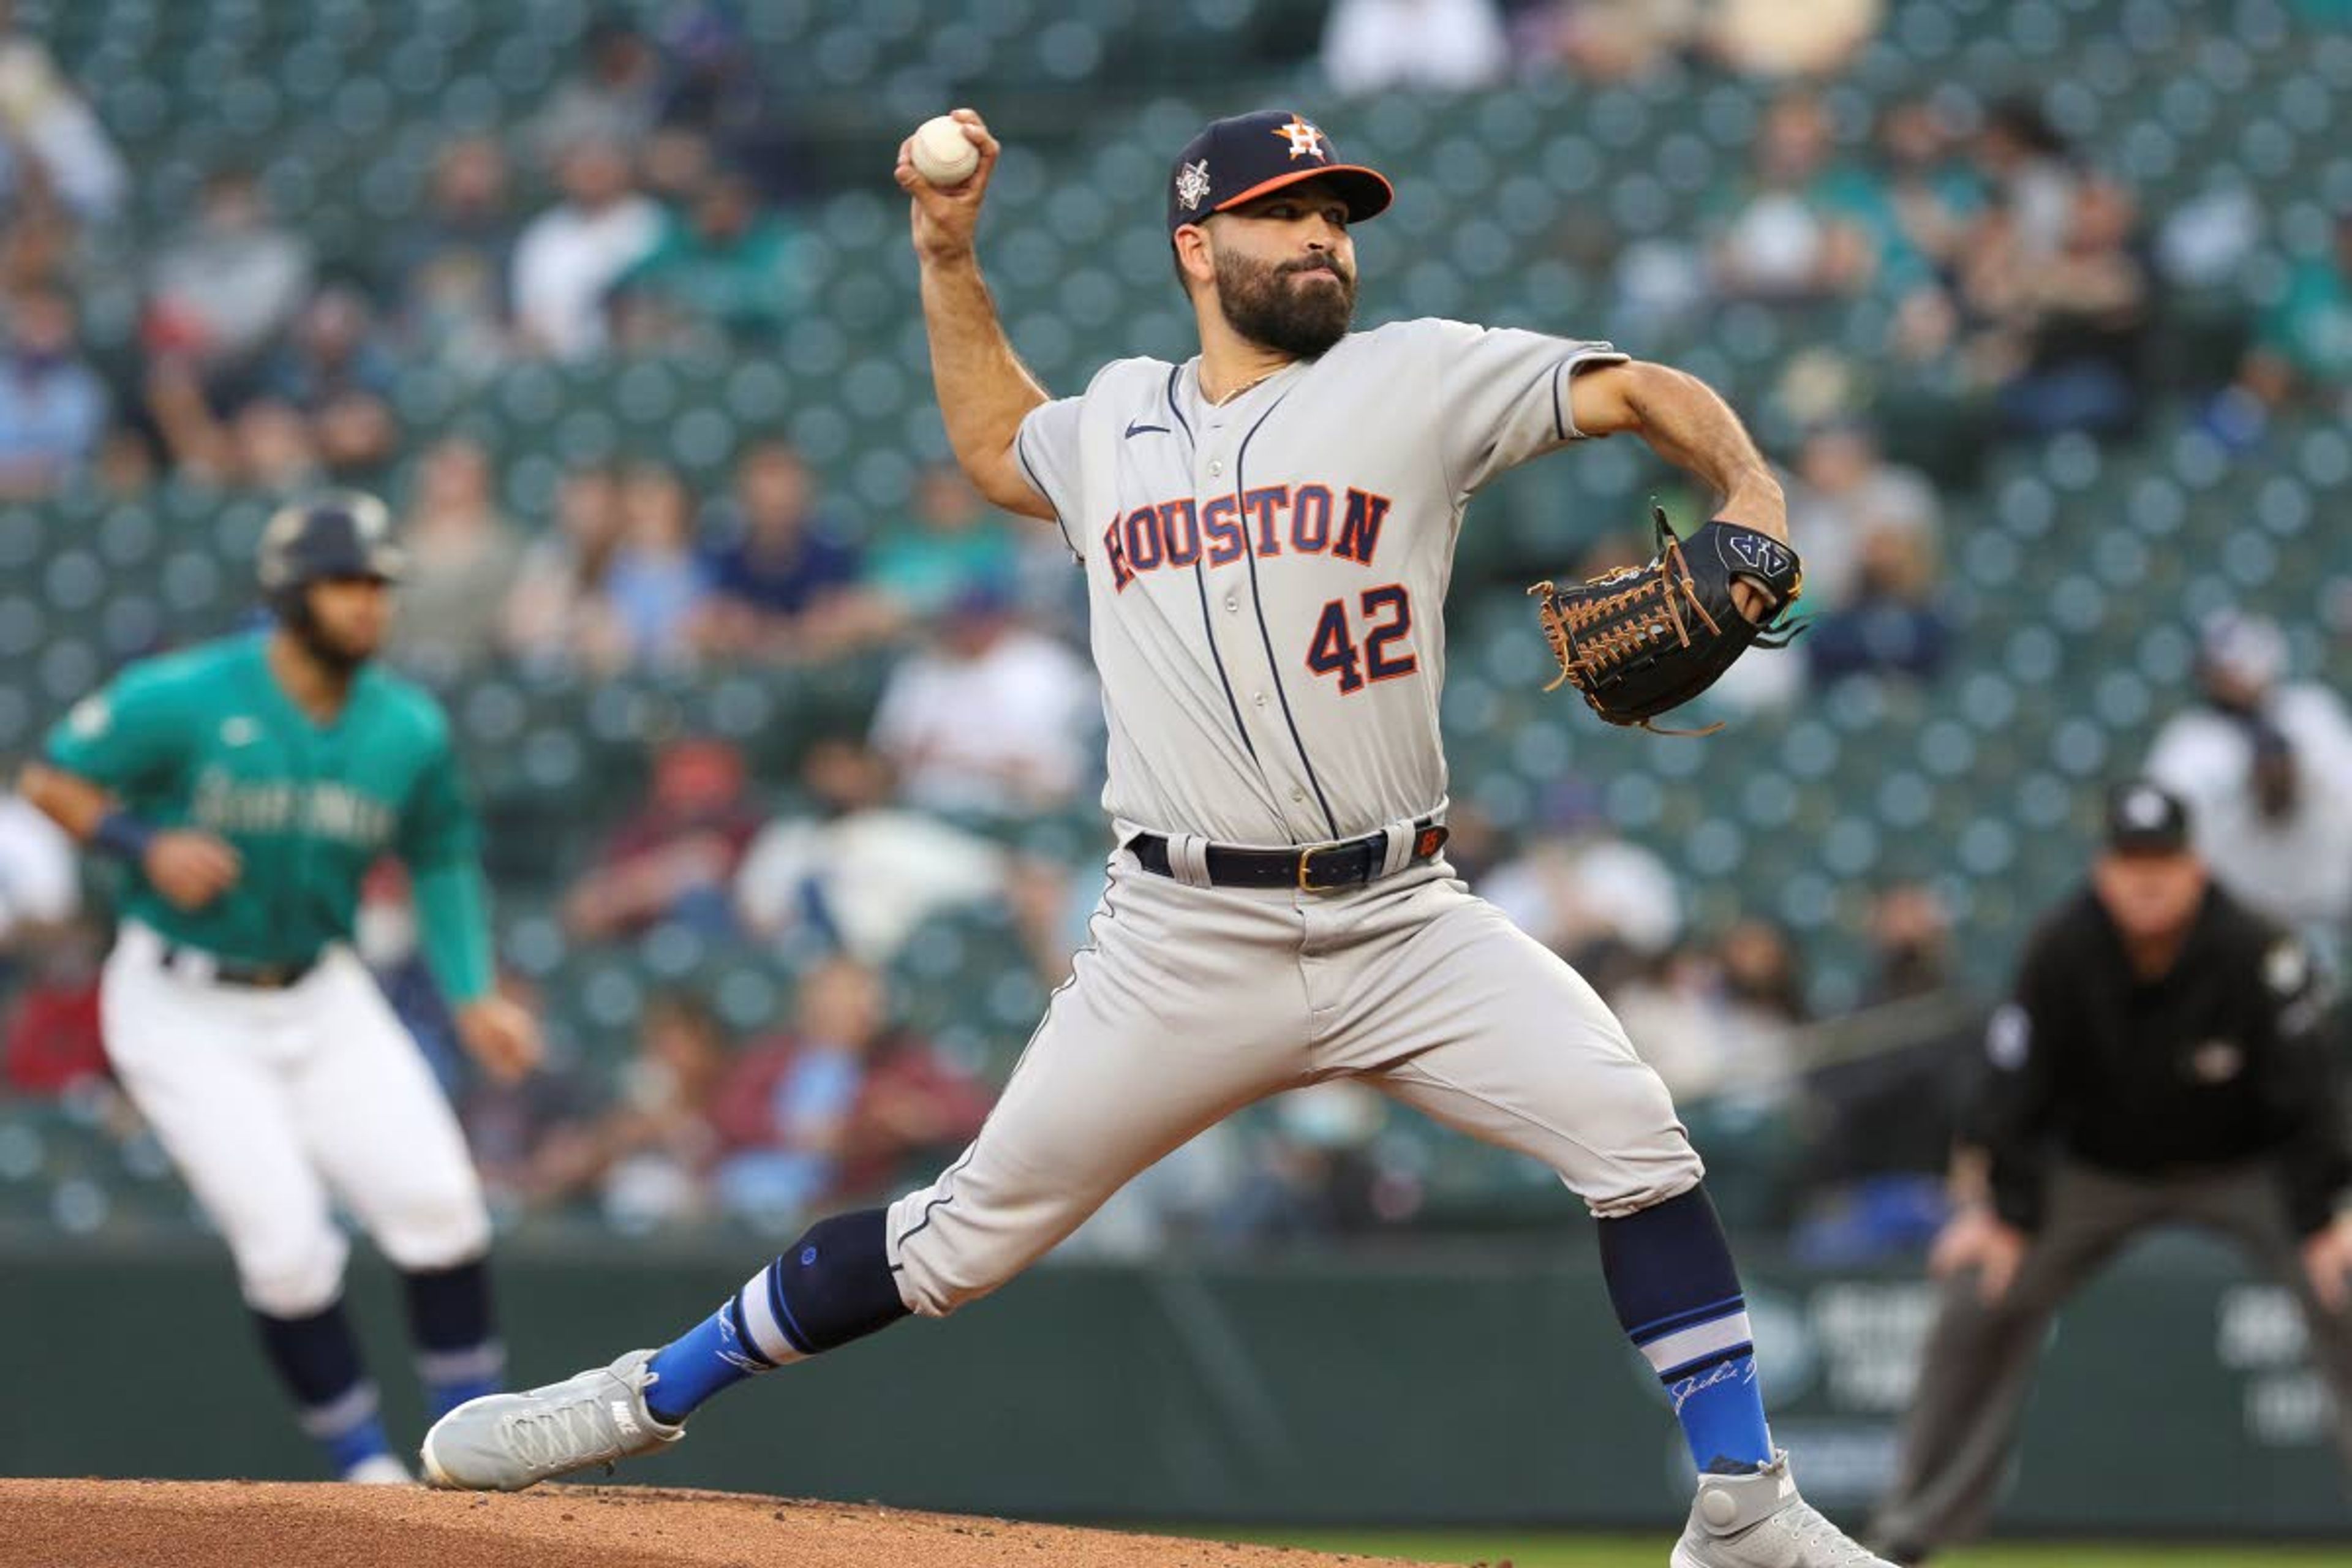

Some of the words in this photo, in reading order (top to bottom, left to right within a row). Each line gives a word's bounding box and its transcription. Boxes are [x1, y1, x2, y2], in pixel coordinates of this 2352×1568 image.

[1281, 122, 1324, 157] H
[1305, 582, 1418, 696] 42
[611, 1401, 642, 1435] NIKE
